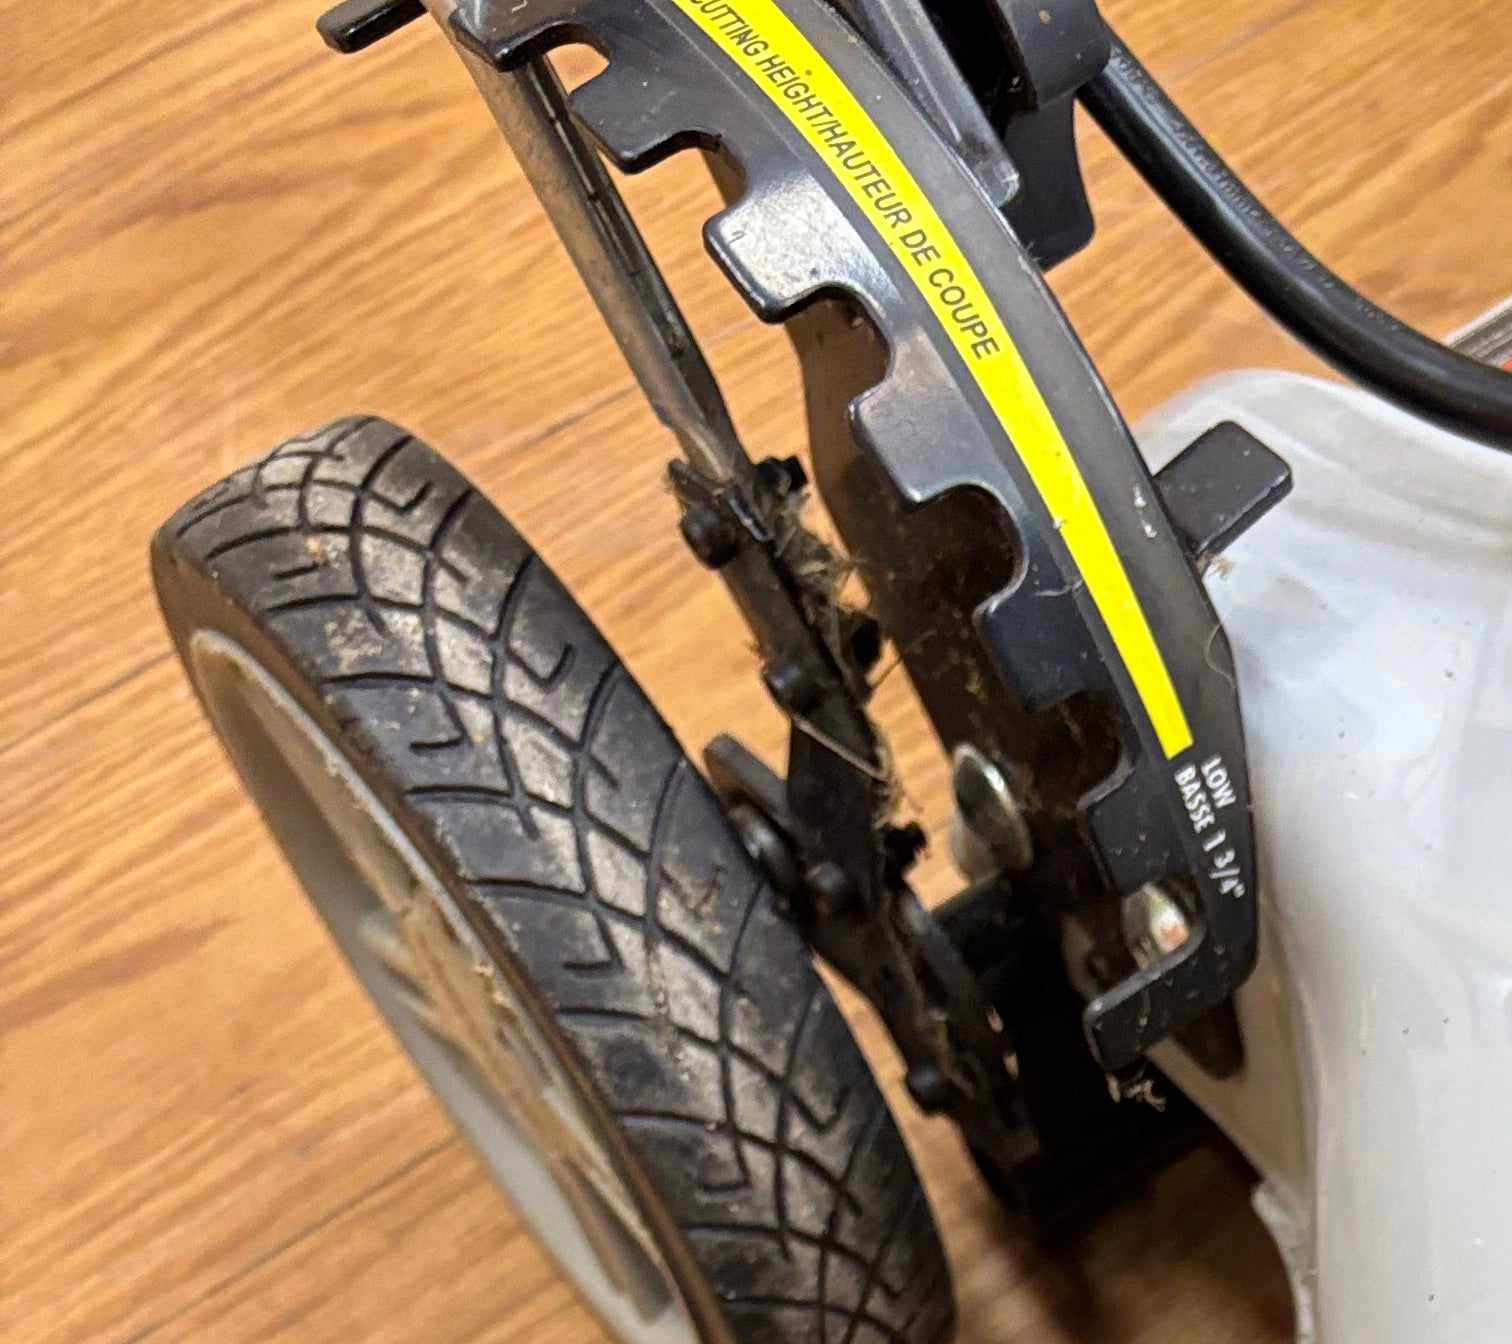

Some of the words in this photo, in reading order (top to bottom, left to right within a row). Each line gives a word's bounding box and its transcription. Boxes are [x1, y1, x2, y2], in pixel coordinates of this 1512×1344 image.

[690, 0, 769, 56] UTTING
[755, 54, 912, 229] HEIGHT/HAUTEUR
[900, 229, 941, 266] DE
[928, 267, 1000, 360] COUPE
[1174, 764, 1215, 833] BASSE
[1203, 829, 1226, 852] 1
[1201, 755, 1236, 808] LOW
